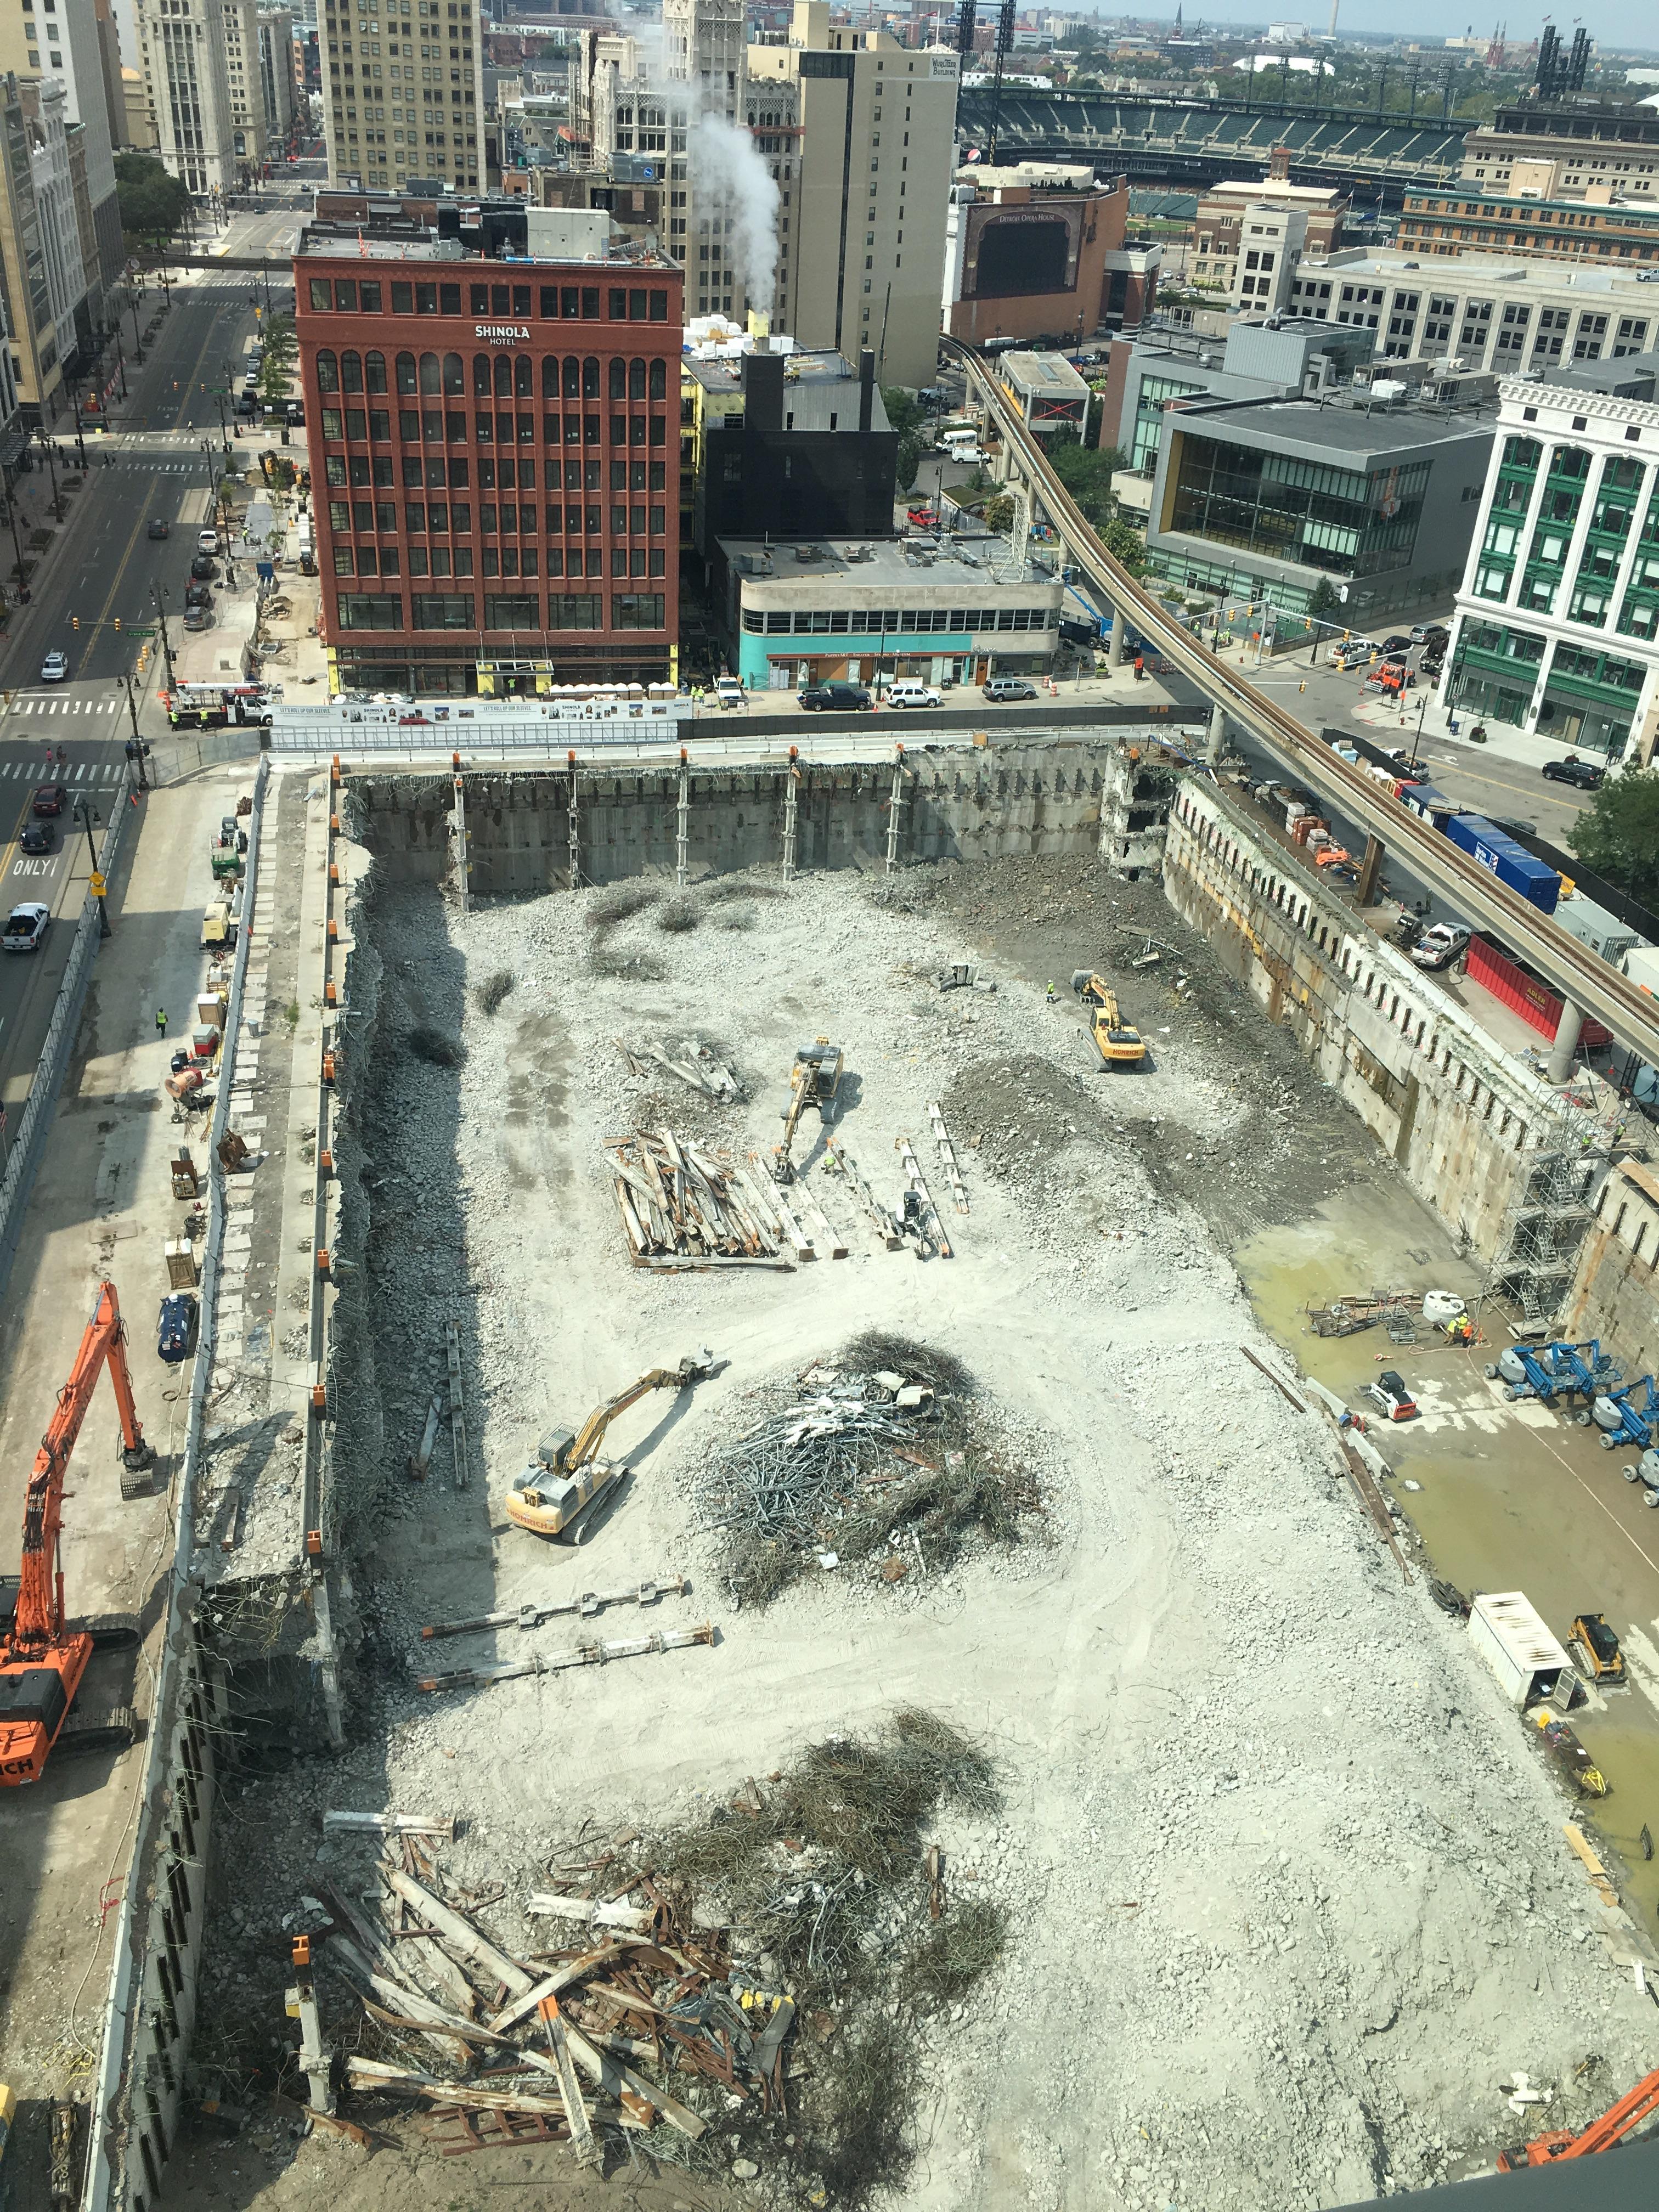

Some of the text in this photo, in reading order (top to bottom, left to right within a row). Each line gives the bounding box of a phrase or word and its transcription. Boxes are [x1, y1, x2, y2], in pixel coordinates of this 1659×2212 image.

[475, 325, 530, 338] SHINOLA
[13, 860, 51, 876] ONLY
[1527, 987, 1545, 1005] ADLER
[510, 1509, 548, 1529] HOMRICH
